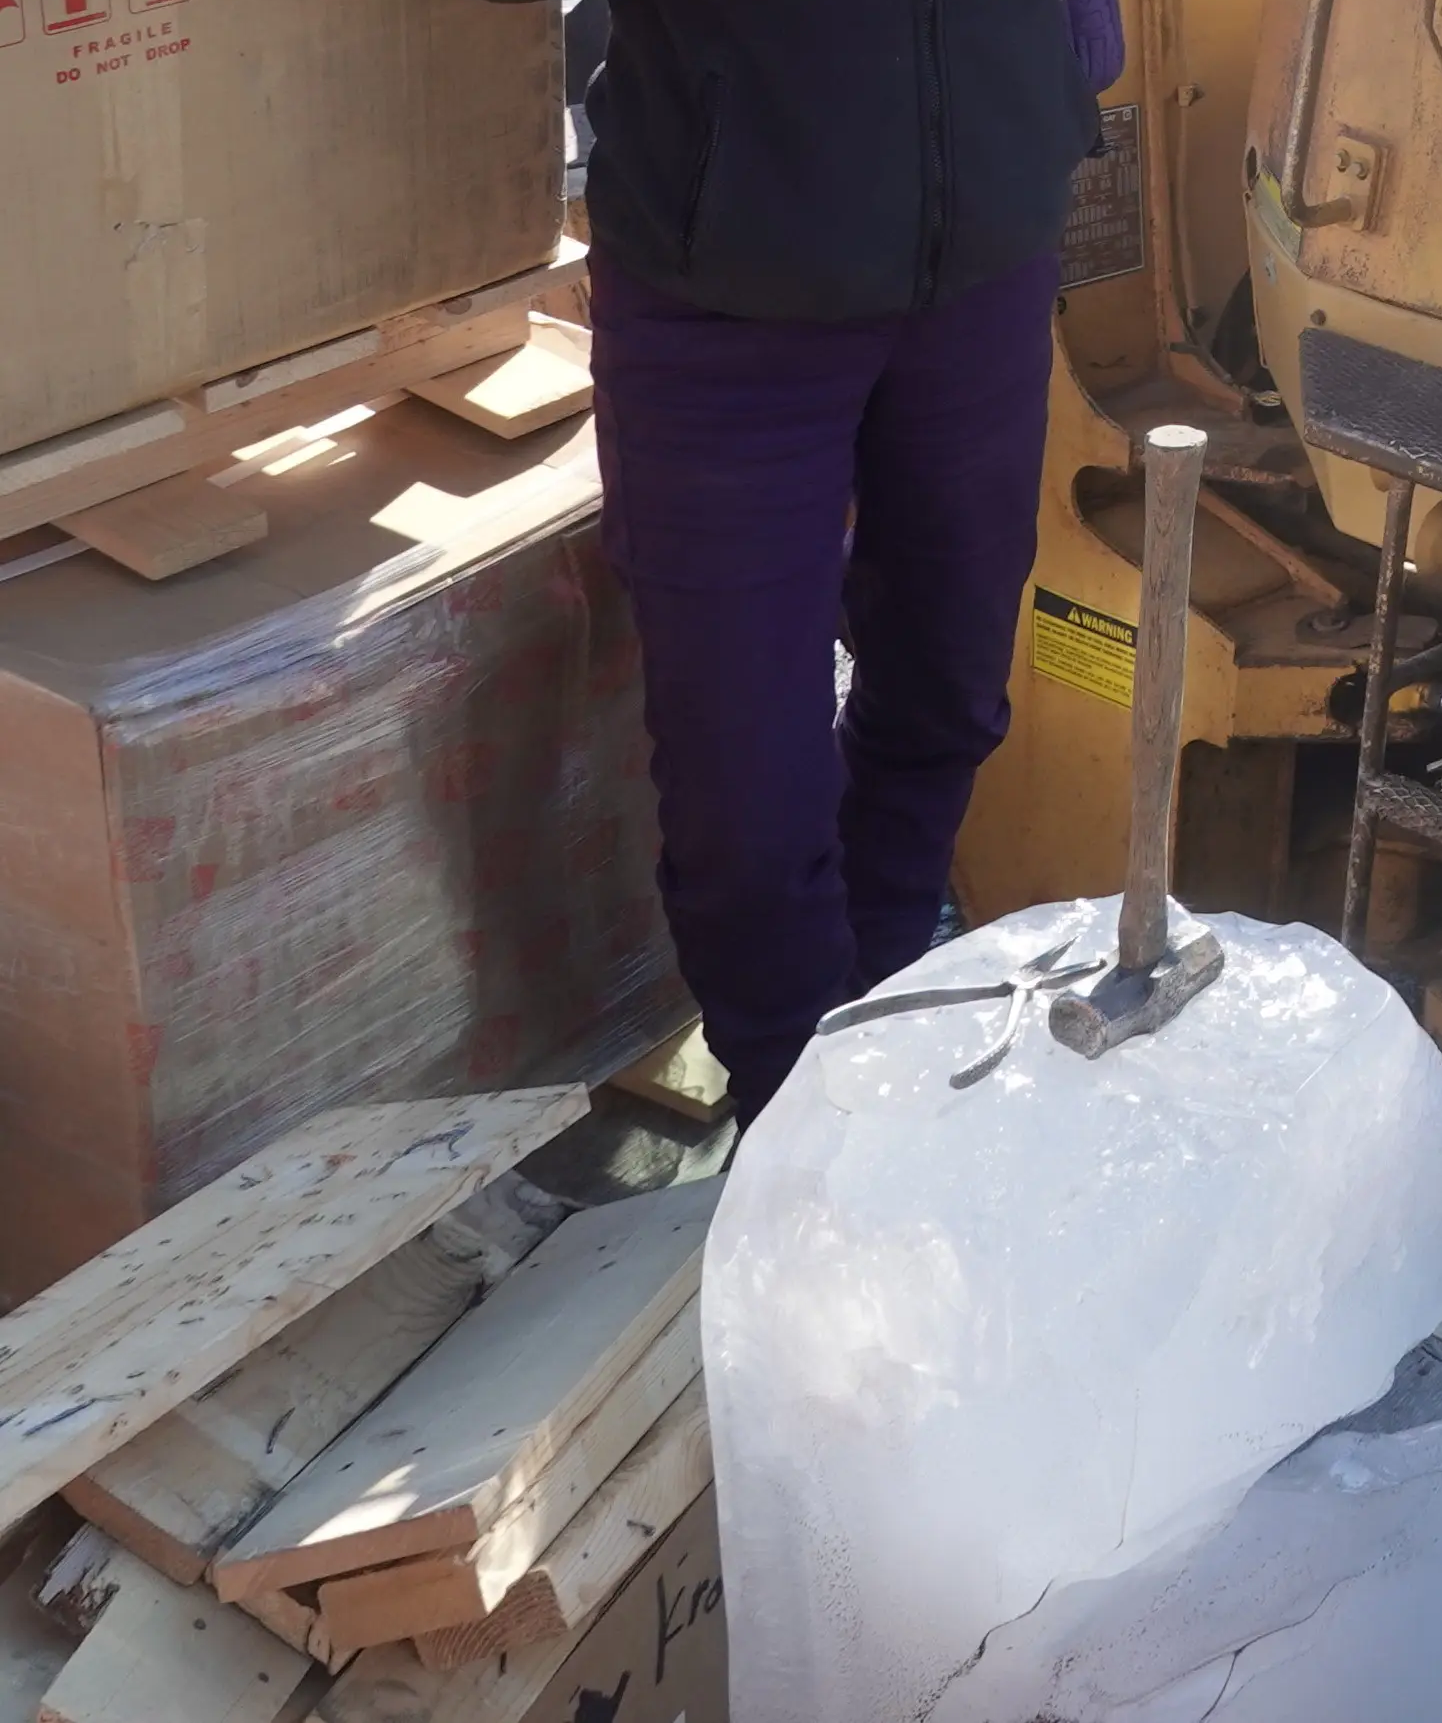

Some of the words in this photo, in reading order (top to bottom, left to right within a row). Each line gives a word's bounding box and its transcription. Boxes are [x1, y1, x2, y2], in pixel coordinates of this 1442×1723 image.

[72, 21, 173, 58] FRAGILE
[55, 67, 81, 84] DO
[96, 54, 132, 74] NOT
[145, 38, 191, 61] DROP
[1081, 612, 1133, 644] WARNING
